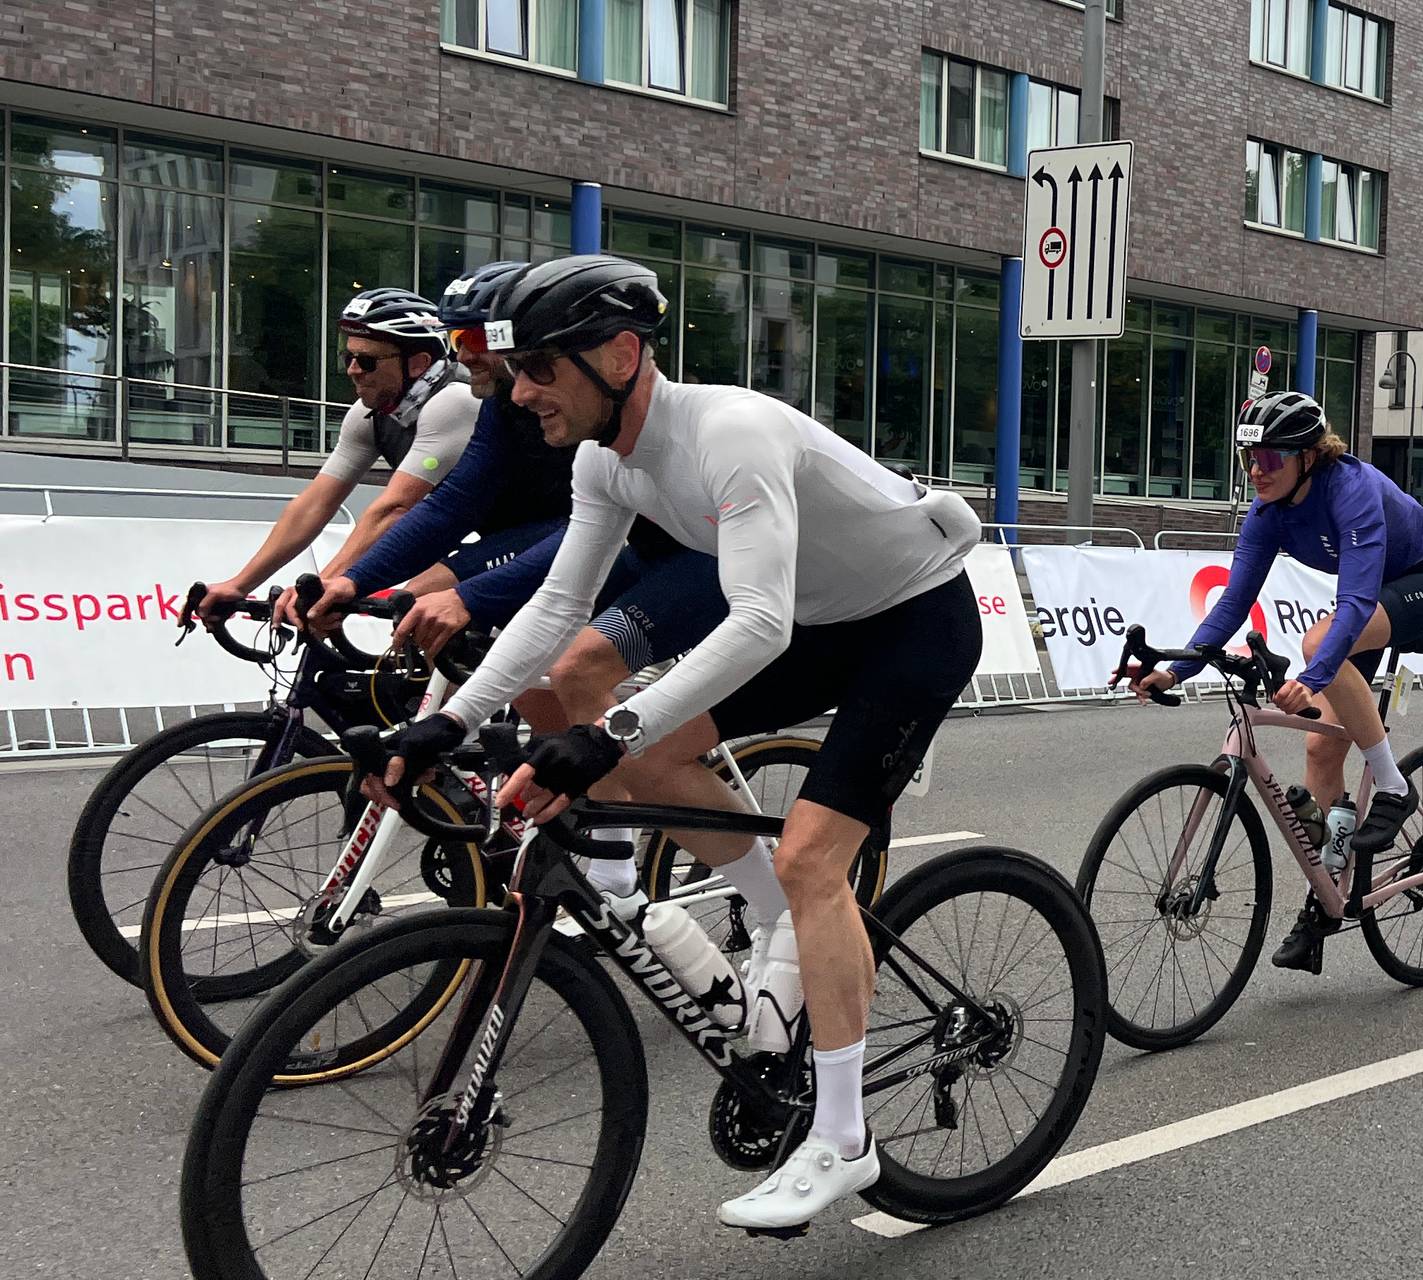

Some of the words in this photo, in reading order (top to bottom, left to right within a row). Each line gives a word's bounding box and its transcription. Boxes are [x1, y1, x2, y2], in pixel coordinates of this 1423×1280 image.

[1239, 428, 1259, 438] 1696
[1404, 594, 1414, 603] LE
[627, 605, 655, 631] GORE
[581, 901, 734, 1067] S-WORKS
[457, 1004, 505, 1125] SPECIALIZED
[906, 1043, 980, 1079] SPECIALIZED
